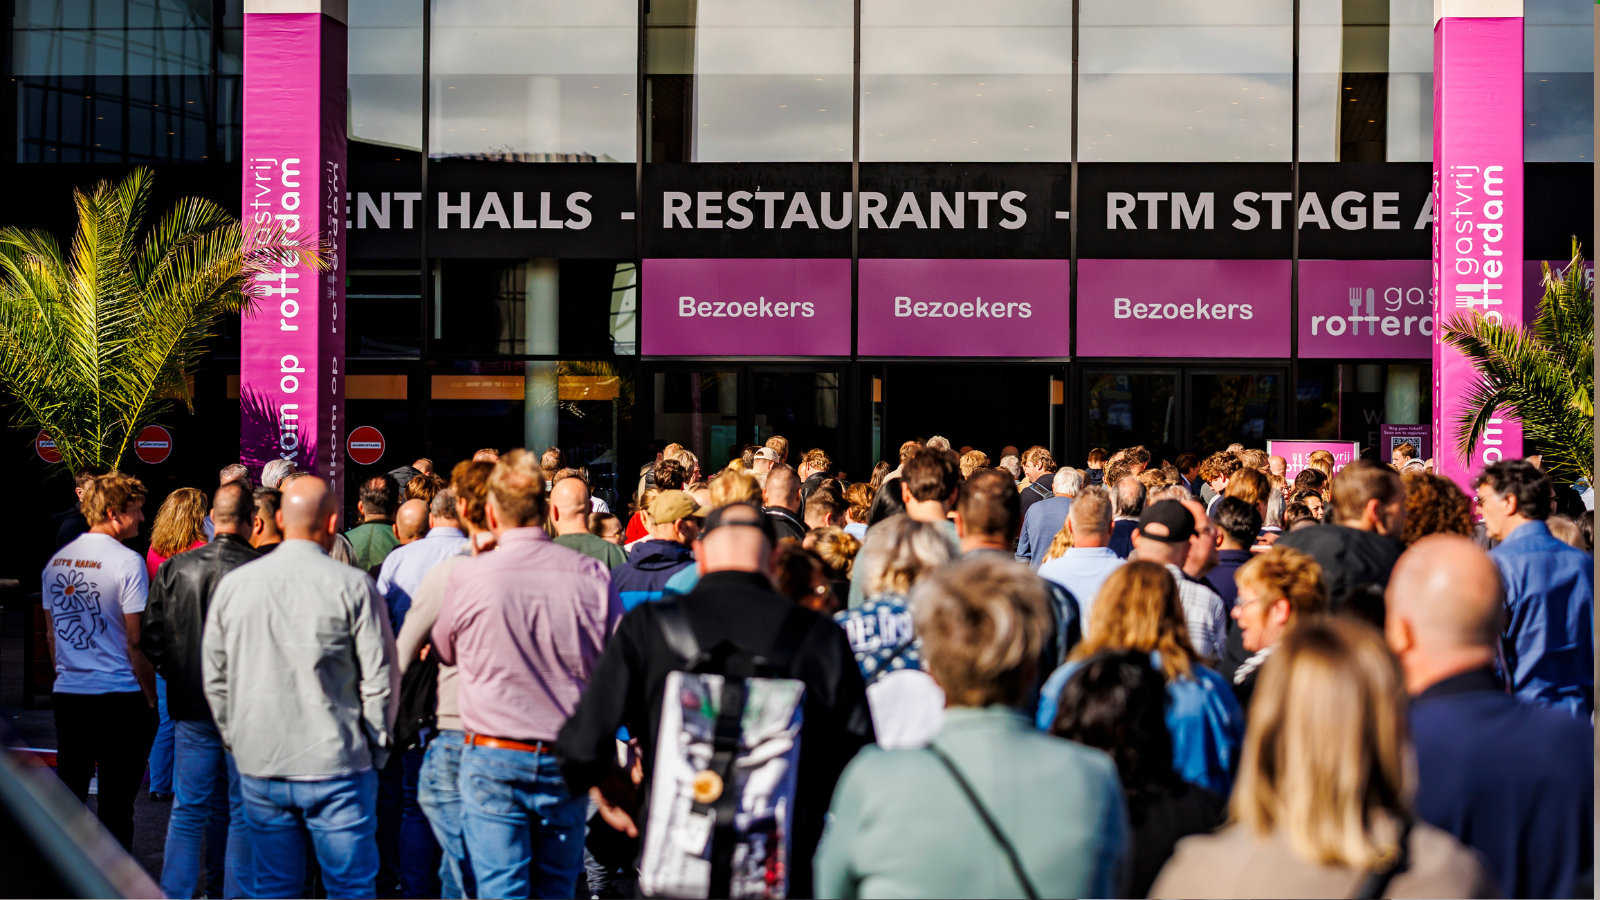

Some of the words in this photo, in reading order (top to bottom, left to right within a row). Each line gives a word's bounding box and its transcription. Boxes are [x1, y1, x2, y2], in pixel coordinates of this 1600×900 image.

[437, 191, 593, 230] HALLS
[662, 190, 1028, 230] RESTAURANTS
[1106, 191, 1215, 230] RTM
[1231, 190, 1401, 231] STAGE
[1450, 165, 1480, 275] gastvrij
[274, 158, 300, 332] rotterdam
[1477, 165, 1504, 327] otterdam
[678, 296, 816, 318] Bezoekers
[894, 296, 1033, 319] Bezoekers
[1113, 297, 1254, 321] Bezoekers
[280, 354, 306, 394] op
